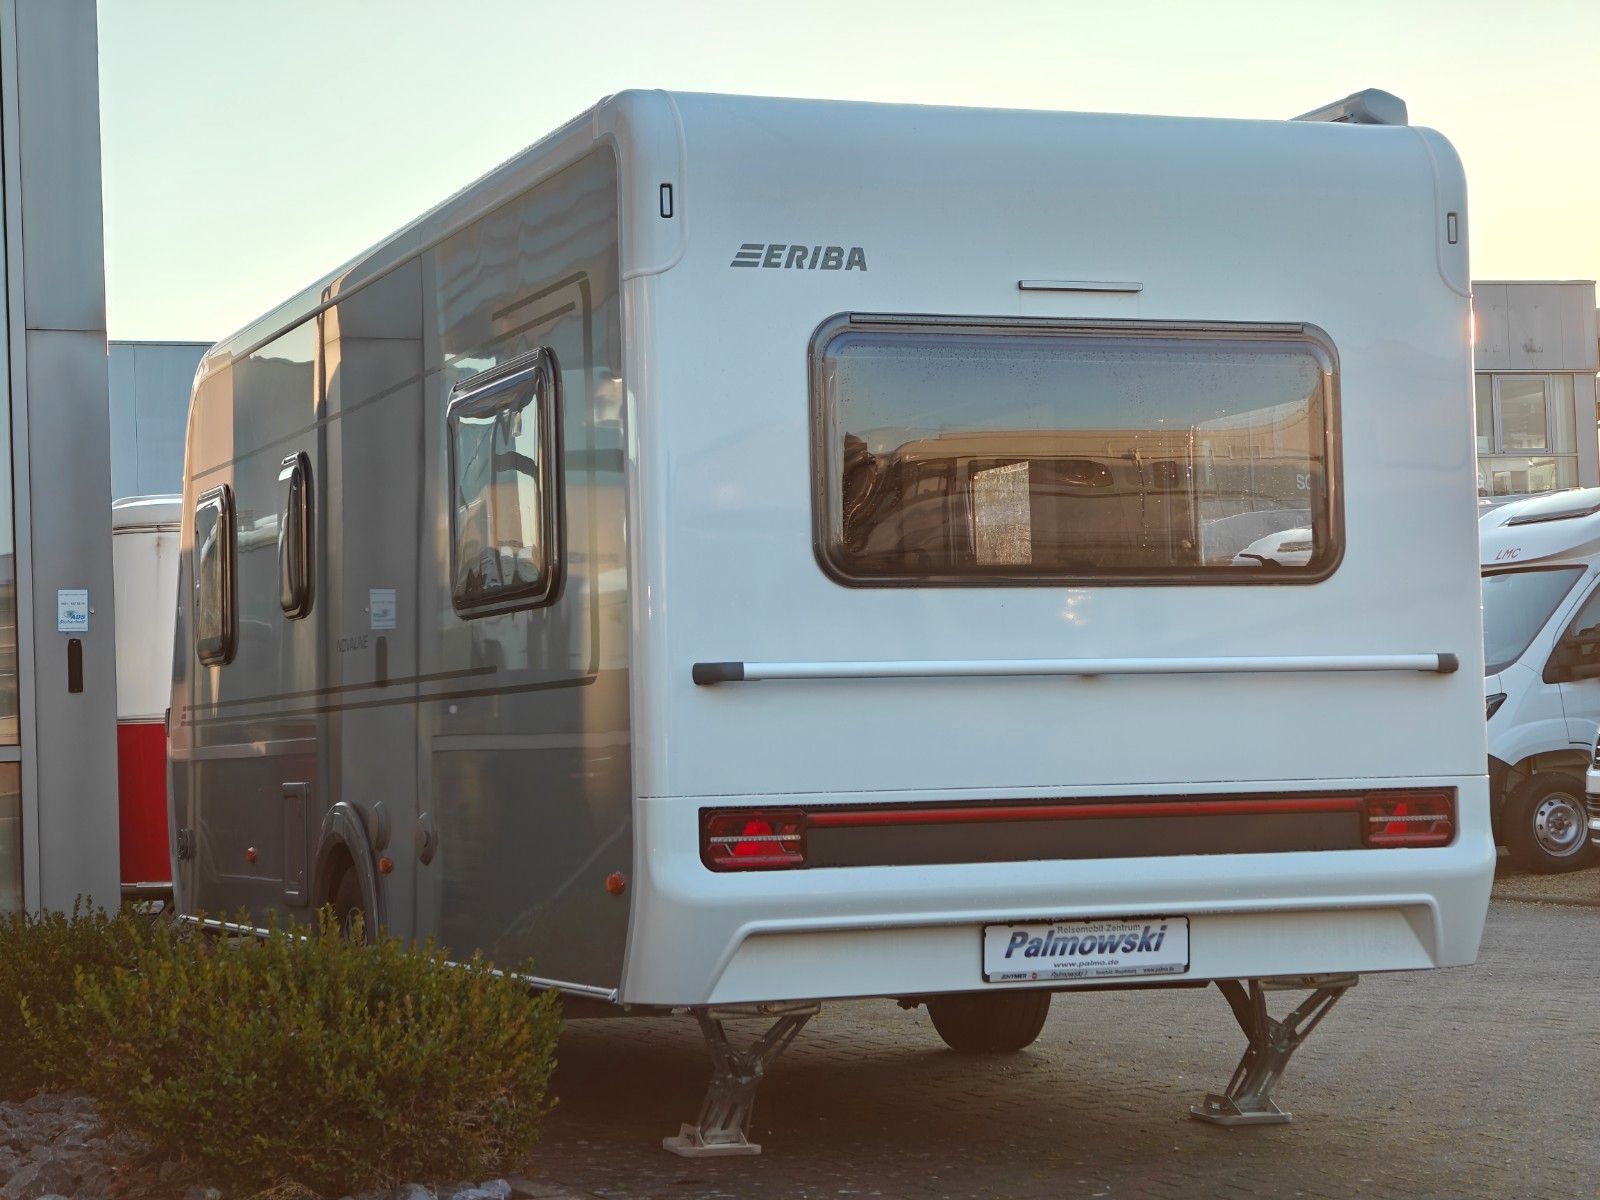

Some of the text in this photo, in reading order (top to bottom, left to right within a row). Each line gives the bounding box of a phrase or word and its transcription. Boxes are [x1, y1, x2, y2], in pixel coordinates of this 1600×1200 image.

[762, 244, 868, 271] ERIBA
[1495, 548, 1521, 561] LMC
[1004, 925, 1168, 959] Palmowski
